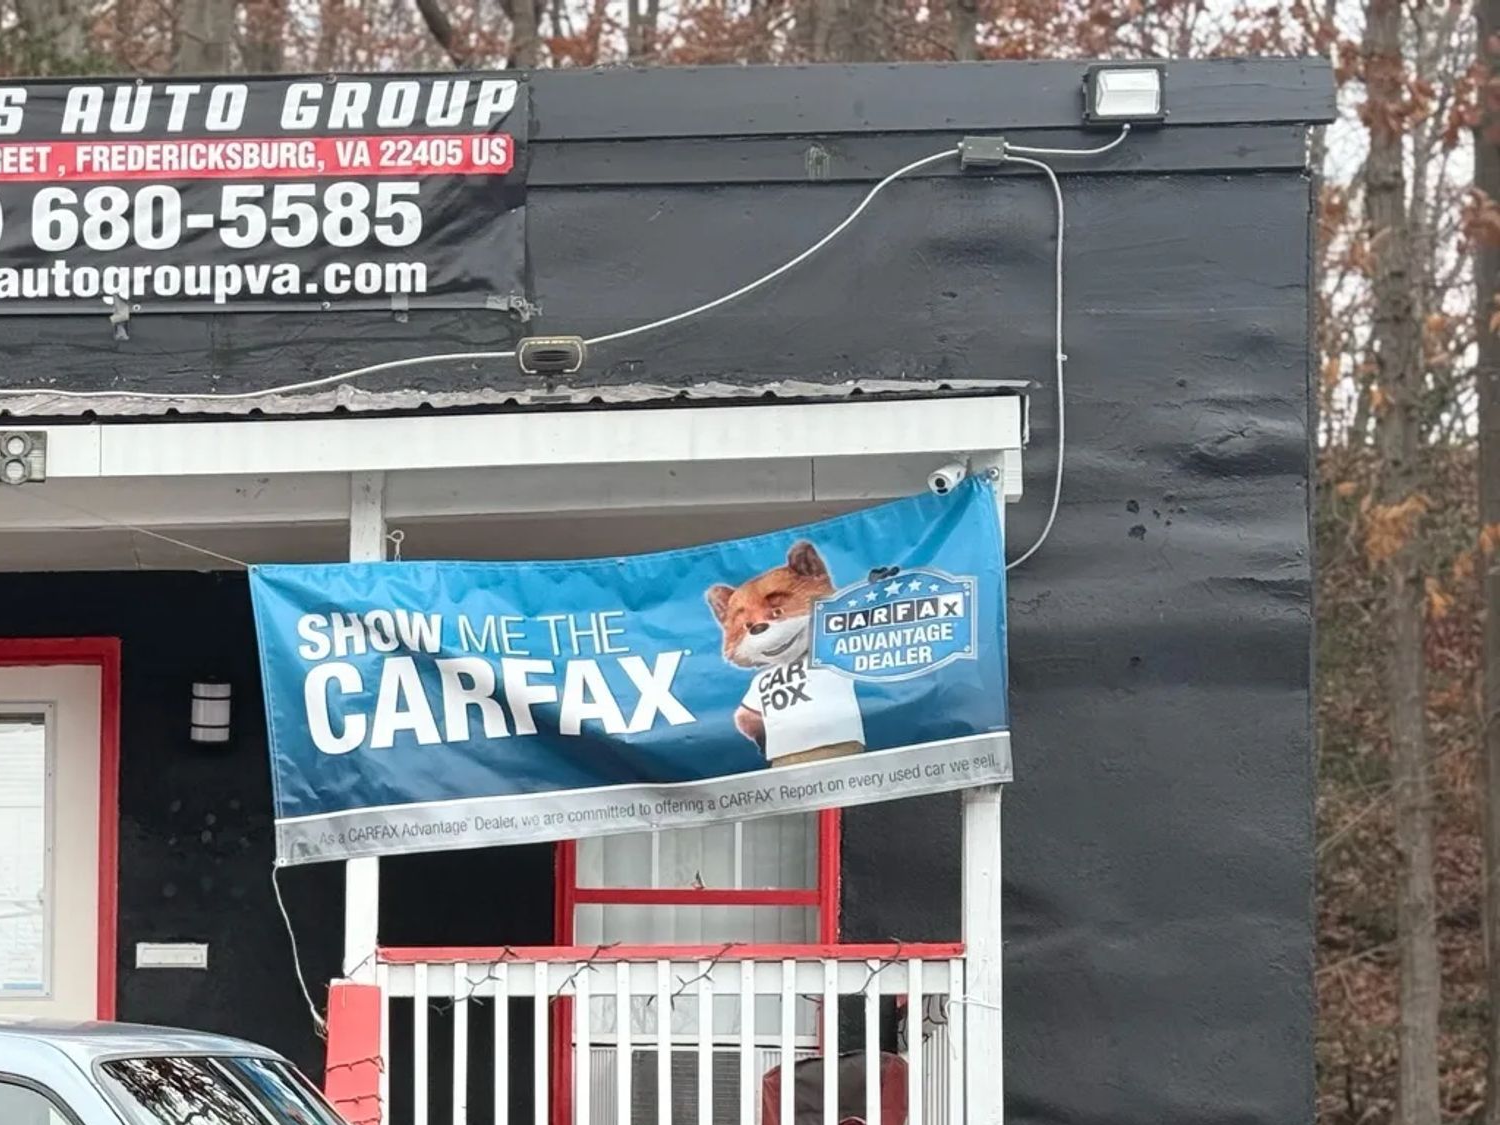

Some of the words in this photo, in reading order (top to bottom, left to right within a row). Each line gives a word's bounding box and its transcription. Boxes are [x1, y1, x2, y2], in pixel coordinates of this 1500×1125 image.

[61, 83, 248, 134] AUTO
[280, 80, 519, 131] GROUP
[76, 142, 326, 173] FREDERICKSBURG,
[336, 140, 372, 167] VA
[379, 139, 463, 166] 22405
[472, 138, 507, 165] US
[31, 181, 422, 251] 680-5585
[826, 600, 960, 632] CARFAX
[297, 609, 442, 660] SHOW
[458, 615, 530, 656] ME
[538, 611, 630, 656] THE
[834, 623, 954, 656] ADVANTAGE
[758, 659, 807, 691] CAR
[854, 645, 932, 672] DEALER
[304, 650, 696, 755] CARFAX
[762, 681, 812, 716] FOX
[319, 831, 336, 845] As
[338, 833, 346, 844] a
[349, 826, 399, 842] CARFAX
[474, 816, 518, 831] Dealer,
[521, 816, 539, 826] we
[543, 813, 564, 824] are
[568, 804, 636, 822] committed
[638, 803, 651, 816] to
[654, 797, 704, 816] offering
[707, 800, 716, 810] a
[780, 781, 825, 800] Report
[828, 779, 845, 791] on
[848, 773, 883, 792] every
[889, 763, 921, 782] used
[925, 763, 946, 777] car
[949, 760, 969, 773] we
[973, 753, 1000, 770] sell.
